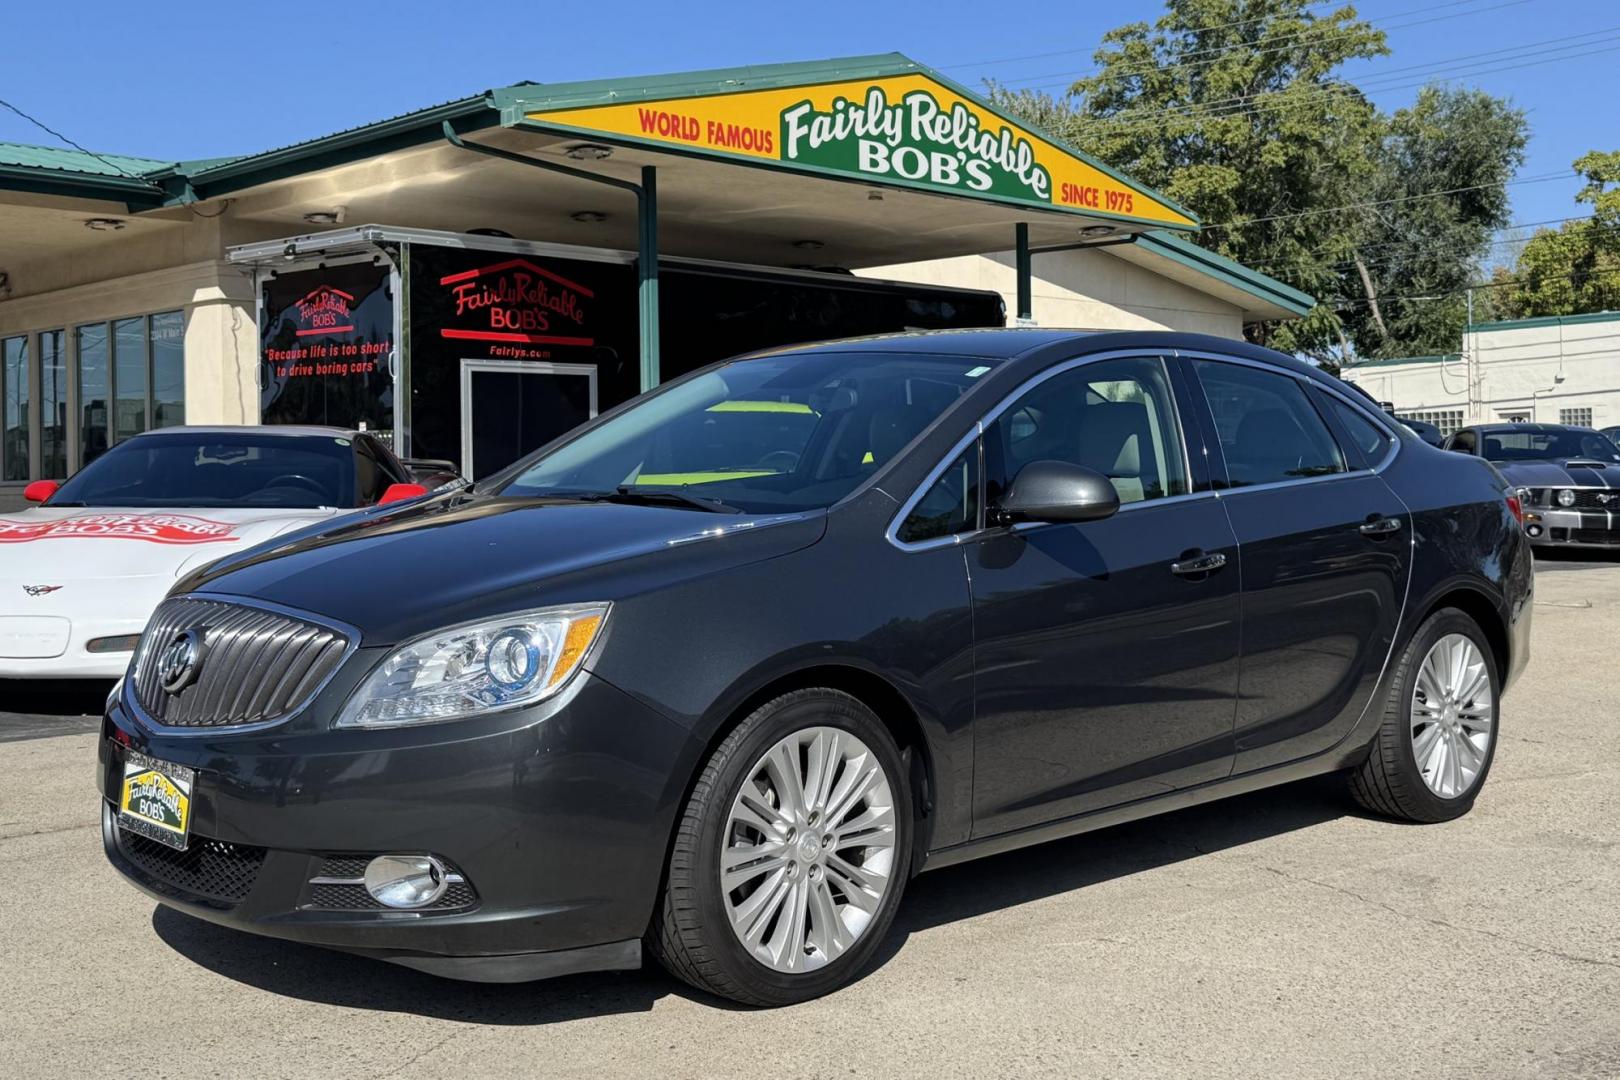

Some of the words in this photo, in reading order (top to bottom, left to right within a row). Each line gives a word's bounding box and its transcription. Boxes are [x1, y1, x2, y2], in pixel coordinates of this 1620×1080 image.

[638, 108, 700, 141] WORLD
[707, 120, 773, 154] FAMOUS
[784, 90, 904, 159] Fairly
[905, 93, 1050, 199] Reliable
[858, 138, 993, 191] BOB'S
[1061, 182, 1099, 208] SINCE
[1104, 190, 1133, 214] 1975
[451, 277, 515, 315] Fairly
[513, 272, 584, 325] Reliable
[491, 307, 549, 331] BOB'S
[310, 345, 327, 358] life
[329, 344, 339, 357] is
[342, 344, 358, 356] too
[360, 341, 390, 354] short
[489, 345, 552, 359] Fairlys.com
[277, 365, 286, 377] to
[289, 363, 313, 377] drive
[316, 361, 348, 377] boring
[140, 798, 166, 822] BOB'S
